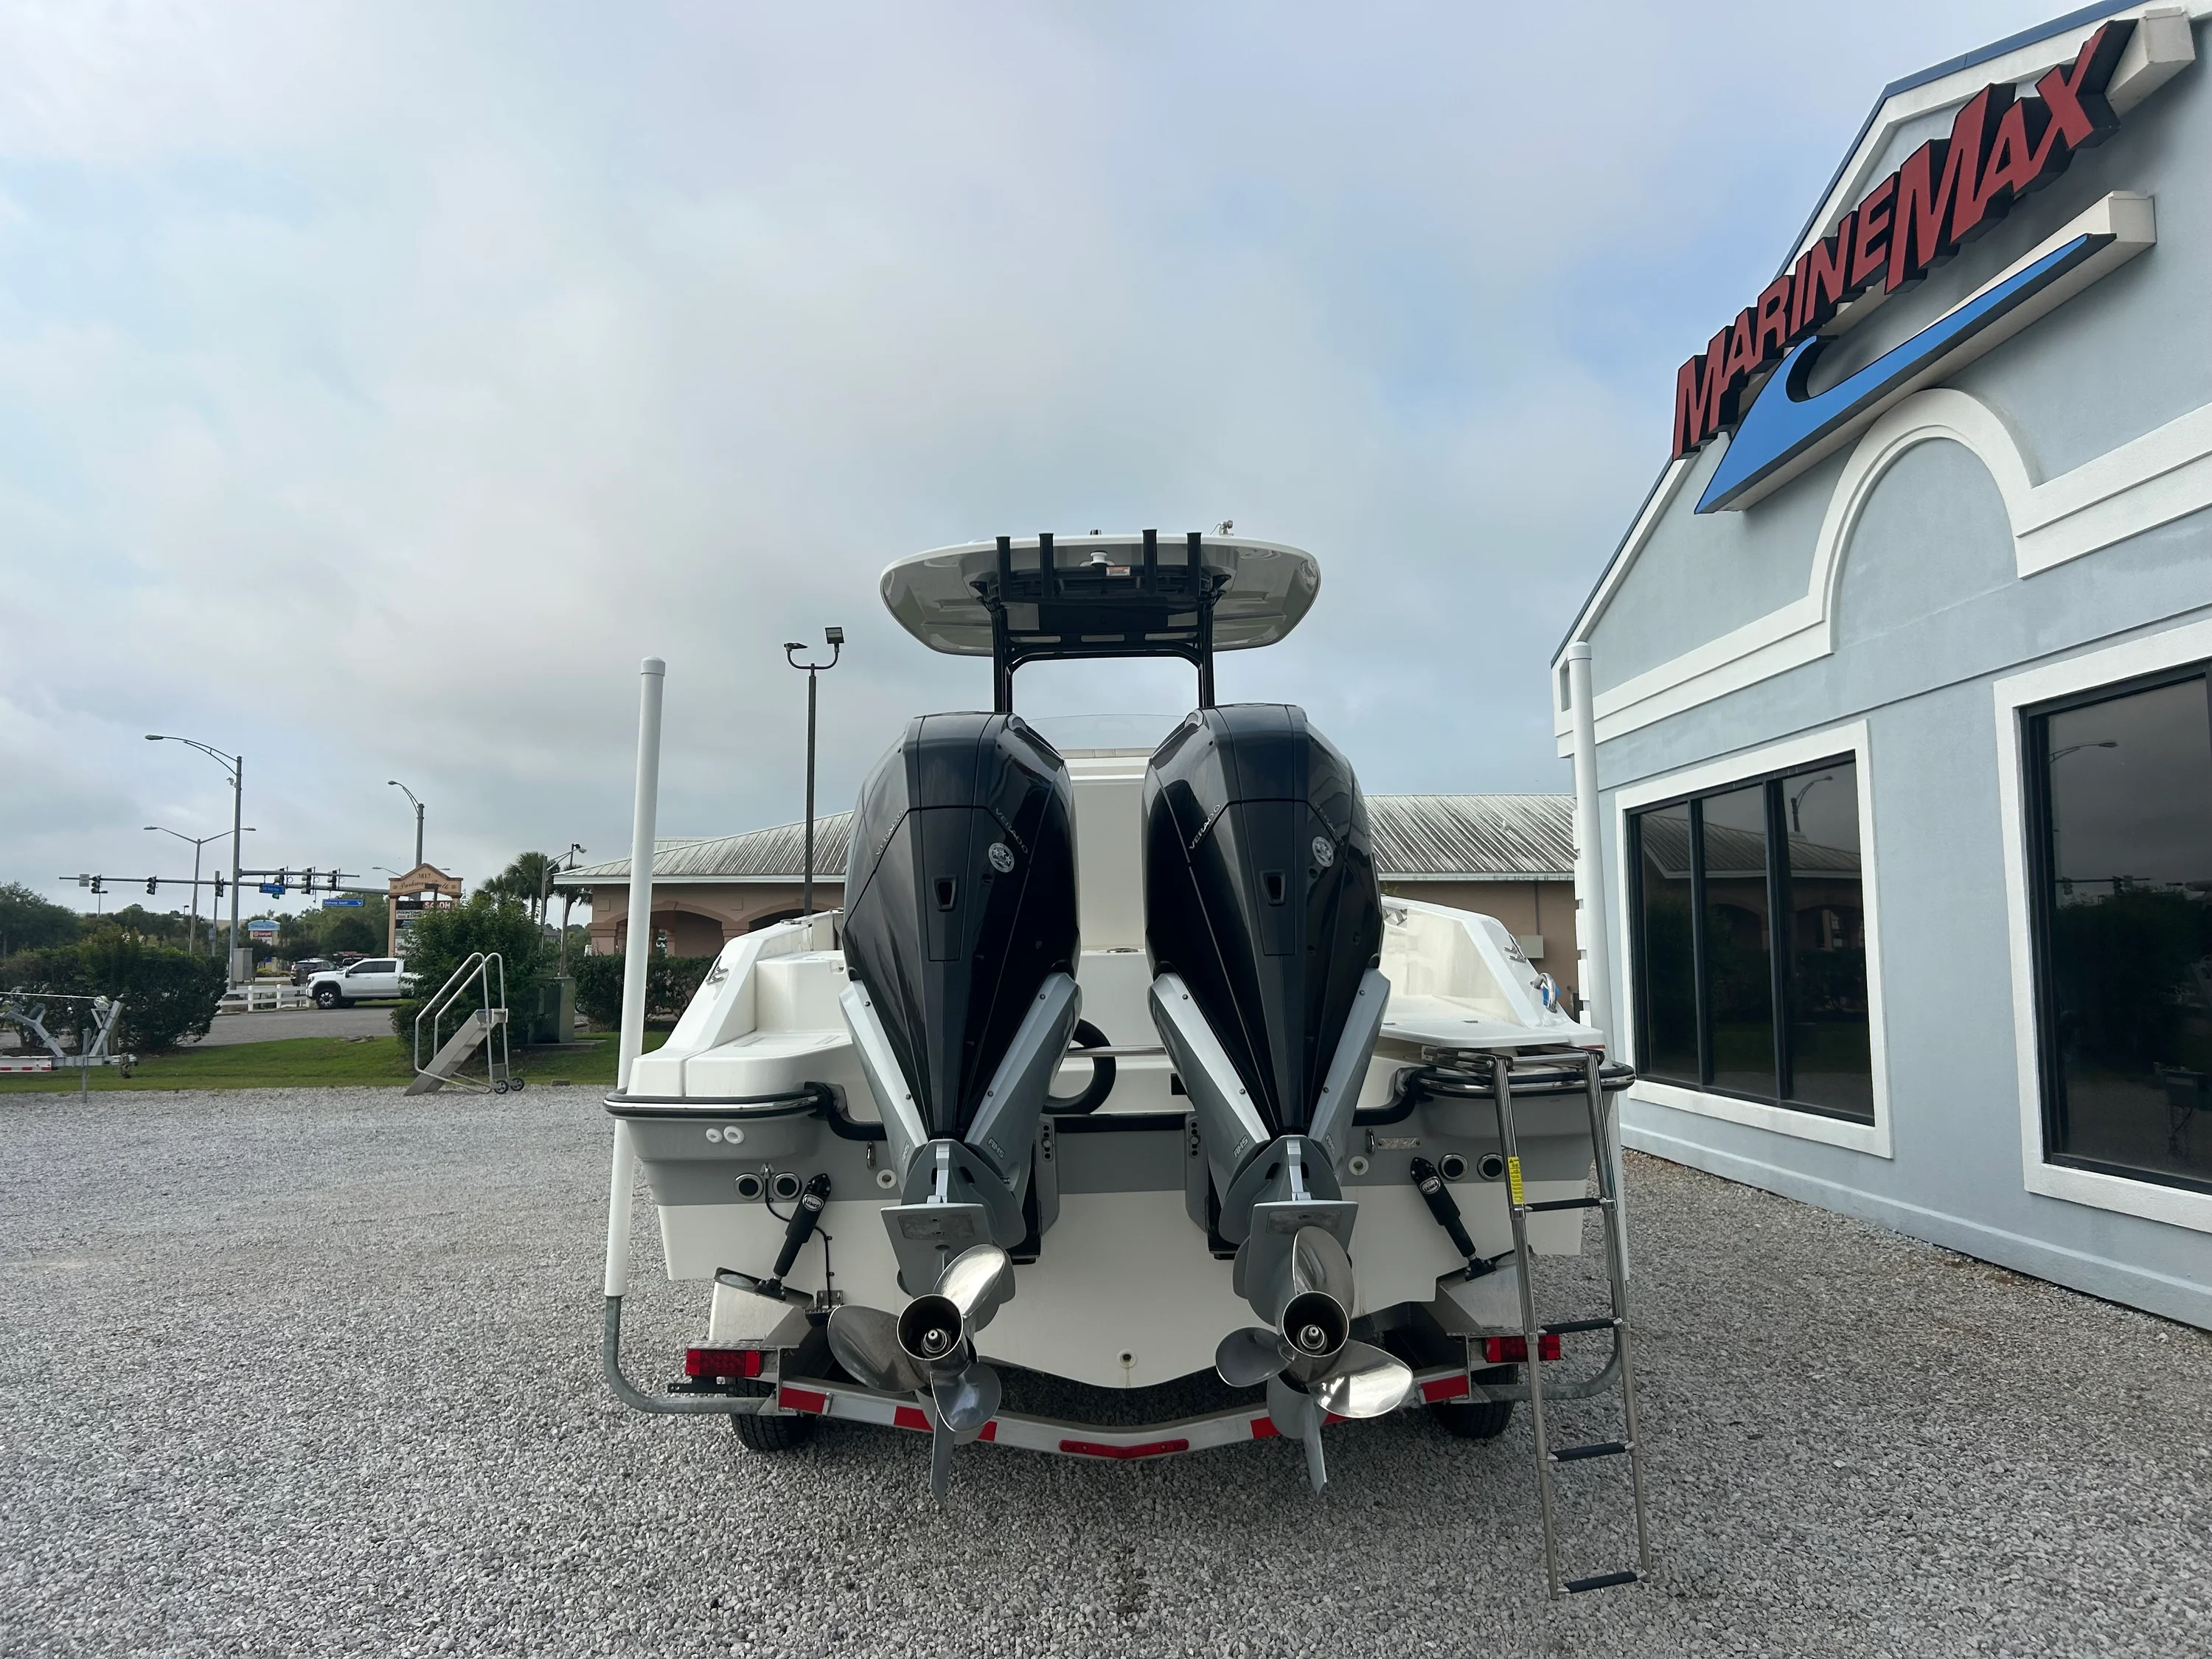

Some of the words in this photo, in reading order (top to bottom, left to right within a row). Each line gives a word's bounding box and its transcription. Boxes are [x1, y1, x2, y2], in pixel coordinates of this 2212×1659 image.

[1672, 20, 2124, 460] MARINEMAX
[876, 810, 903, 855] VERADO
[995, 807, 1028, 853] VERADO
[1189, 804, 1220, 849] VERADO
[987, 1138, 1005, 1158] AMS
[1233, 1135, 1248, 1158] AMS
